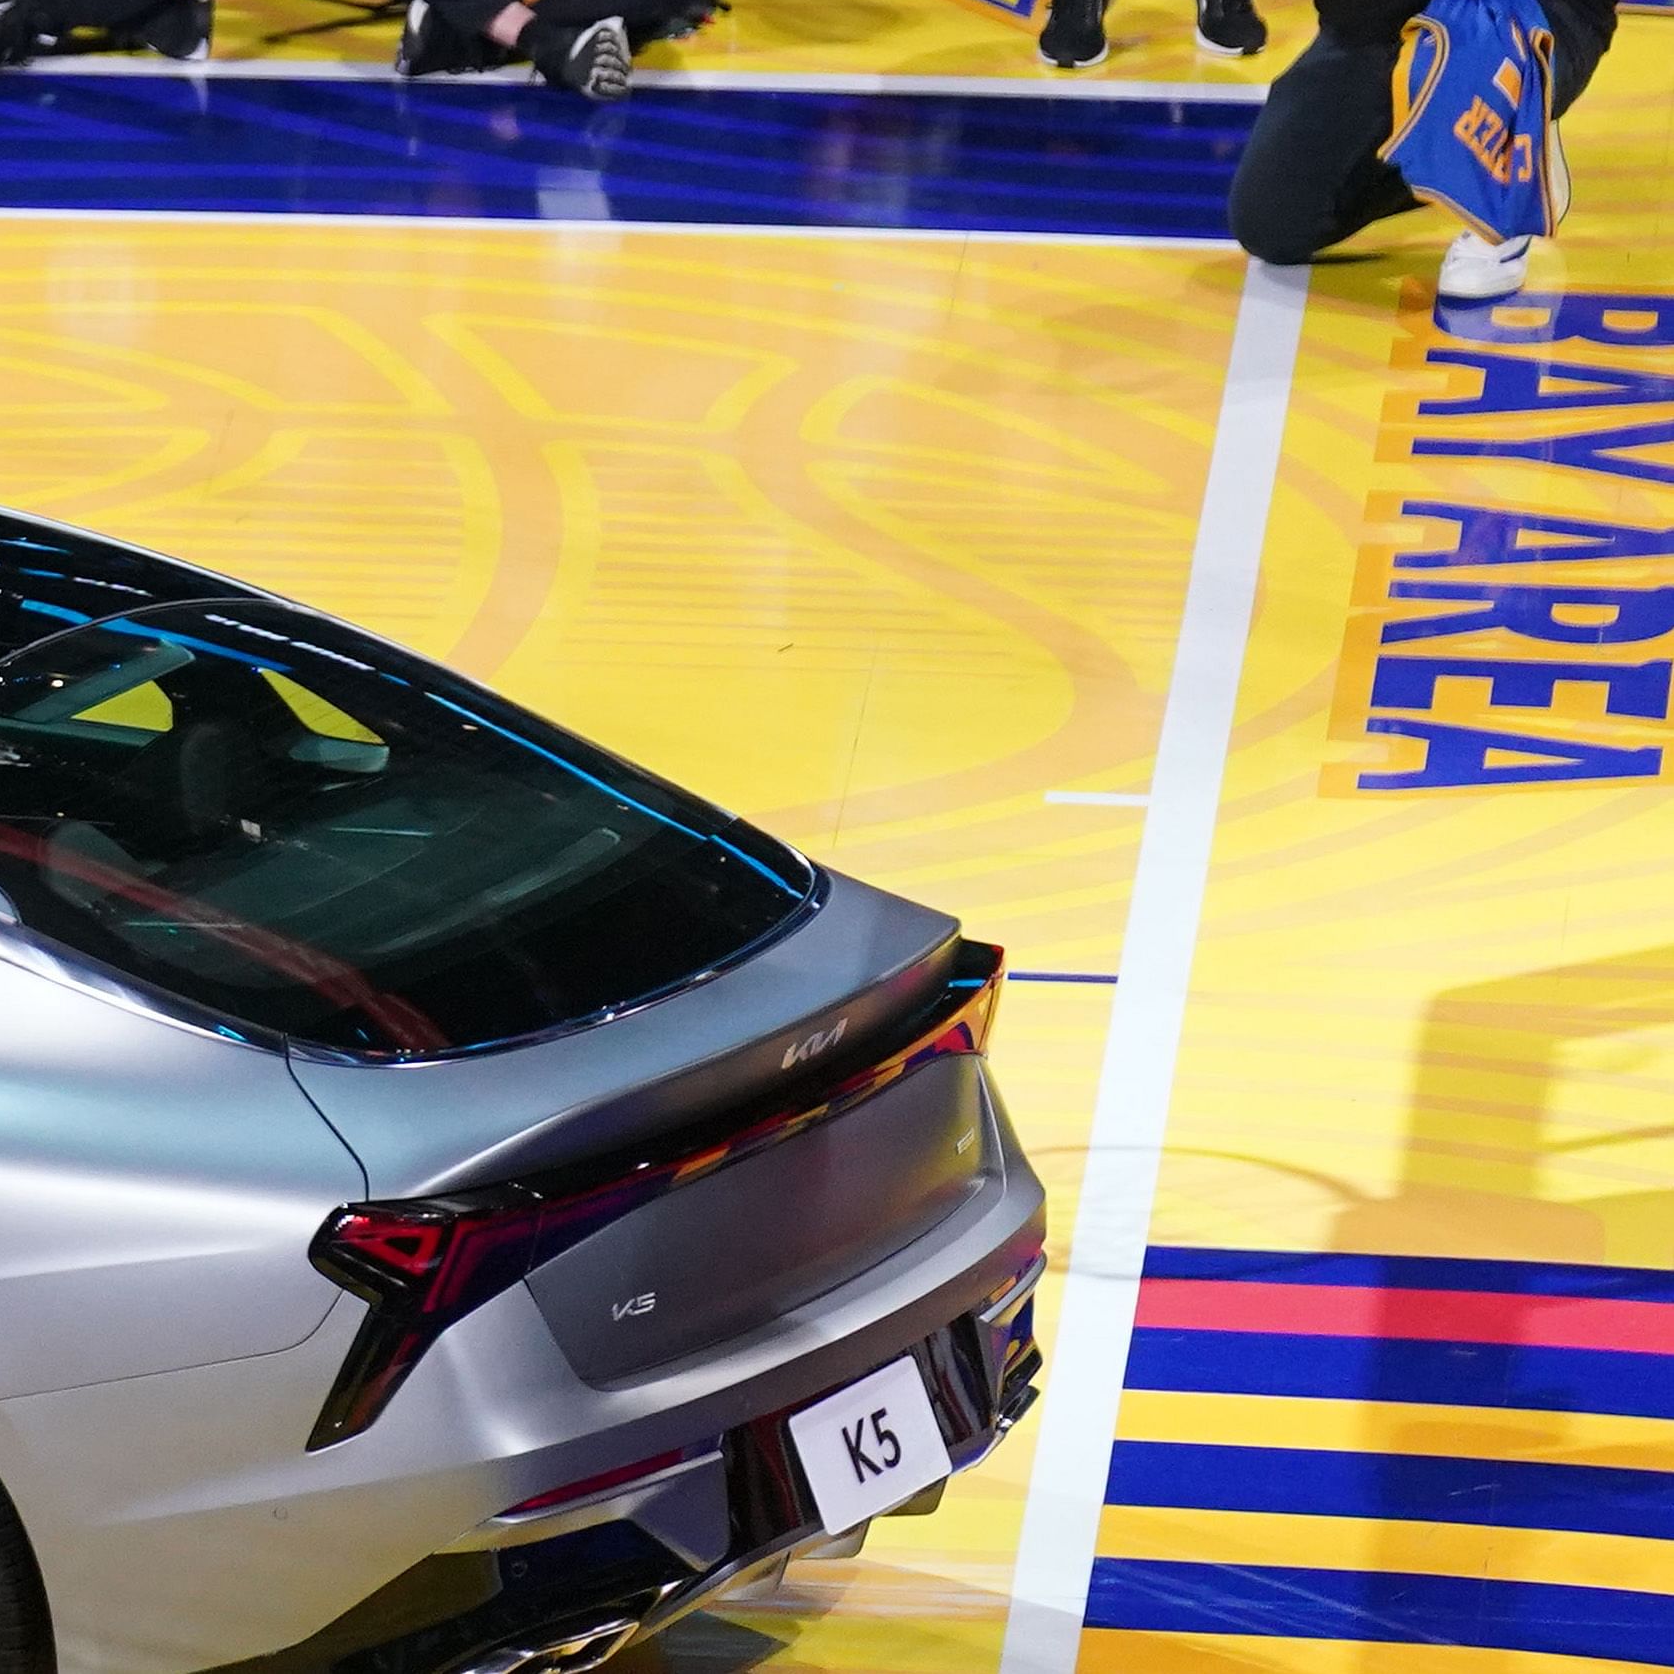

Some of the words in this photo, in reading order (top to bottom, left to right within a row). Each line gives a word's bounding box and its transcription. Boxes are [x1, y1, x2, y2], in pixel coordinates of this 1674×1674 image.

[1356, 499, 1674, 792] AREA
[611, 1291, 657, 1322] K5
[841, 1407, 902, 1485] K5
